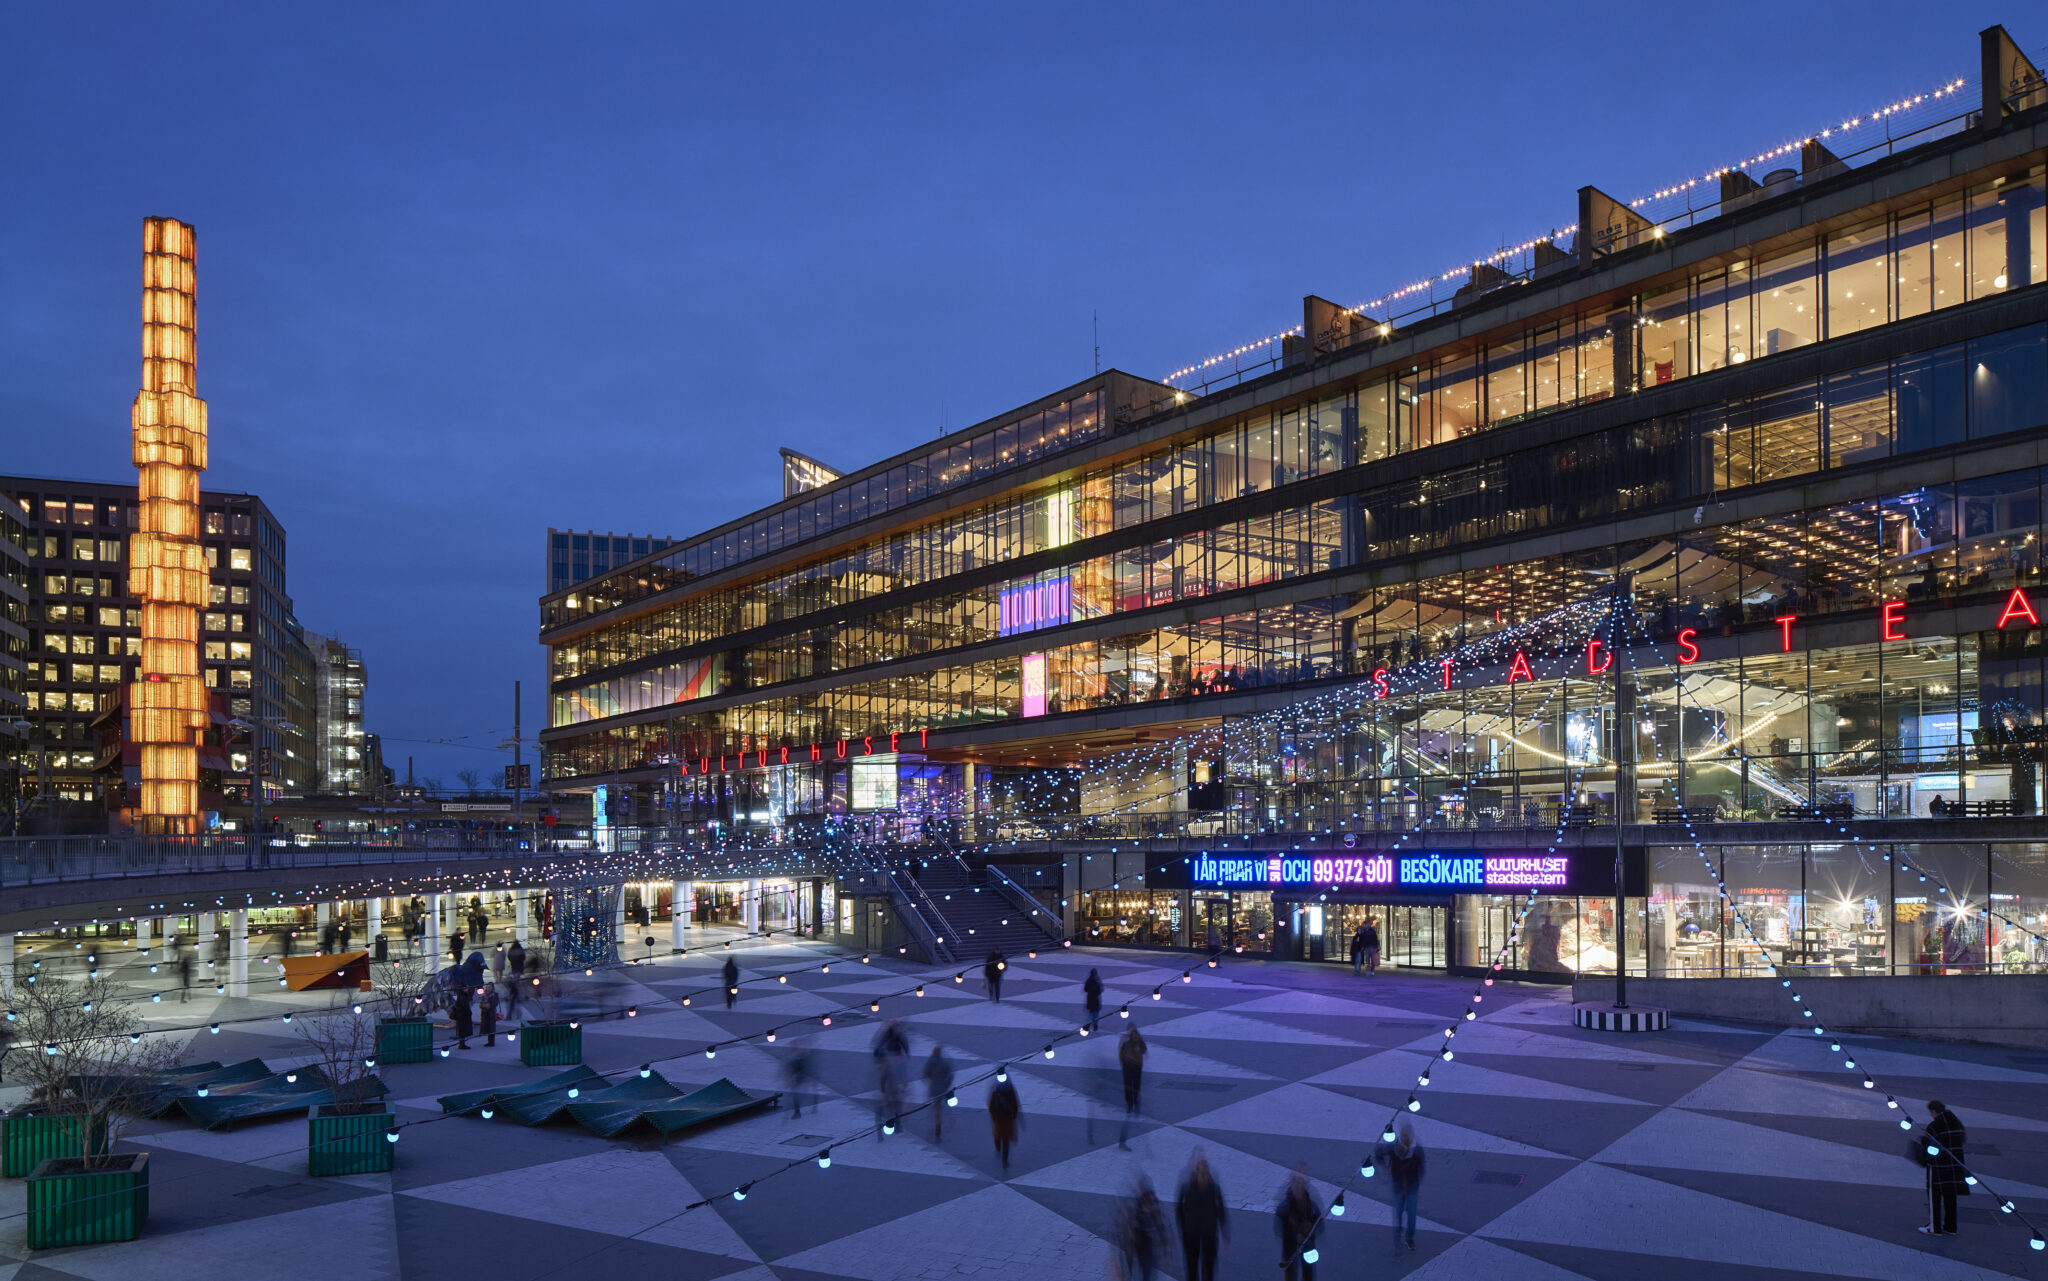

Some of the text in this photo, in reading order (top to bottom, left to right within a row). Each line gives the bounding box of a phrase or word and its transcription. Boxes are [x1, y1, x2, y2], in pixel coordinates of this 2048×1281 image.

[1374, 587, 2039, 697] STADSTEA
[682, 729, 928, 775] KULTURHUSET
[1194, 860, 1199, 881] I
[1200, 855, 1217, 881] ÅR
[1219, 860, 1253, 881] FIRAR
[1255, 860, 1267, 881] VI
[1282, 860, 1311, 882] OCH
[1314, 860, 1333, 882] 99
[1334, 860, 1363, 882] 372
[1366, 860, 1392, 882] 901
[1401, 855, 1484, 883] BESÖKARE
[1486, 859, 1568, 871] KULTURHUSET
[1486, 872, 1566, 884] stadsteatern
